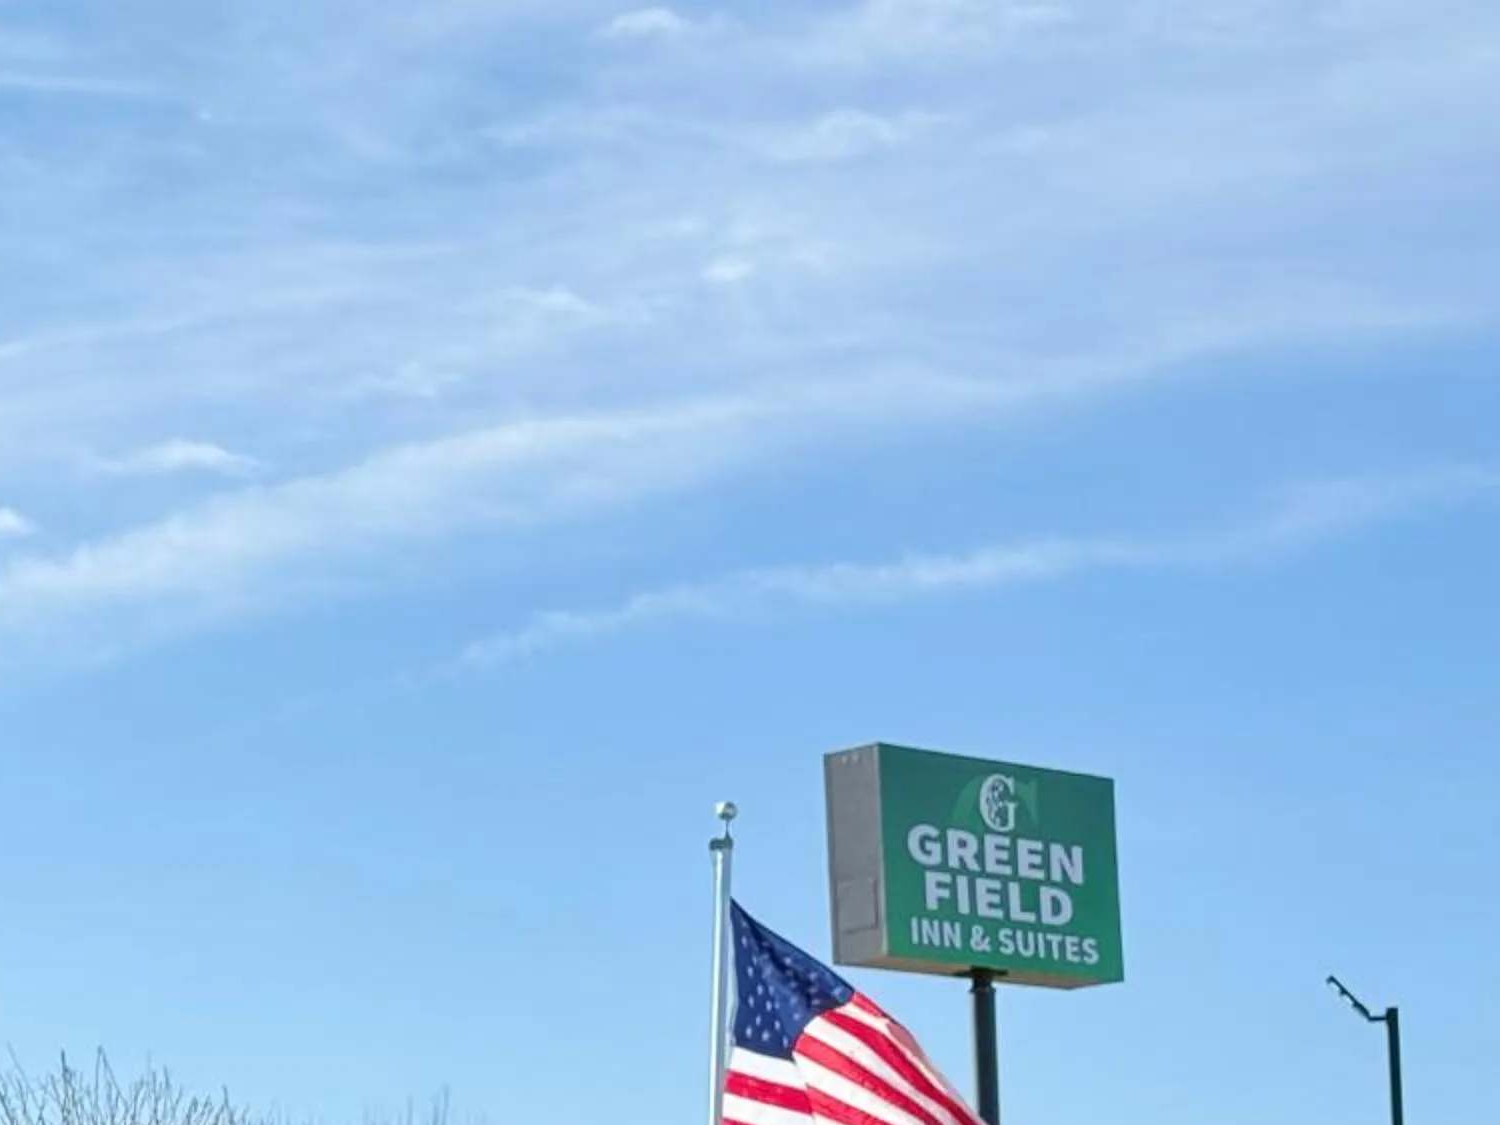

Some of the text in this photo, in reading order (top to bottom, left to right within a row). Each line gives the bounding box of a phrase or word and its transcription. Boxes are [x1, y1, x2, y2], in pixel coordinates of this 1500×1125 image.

[907, 823, 1085, 885] GREEN
[924, 870, 1074, 927] FIELD
[910, 916, 1100, 966] INN & SUITES
